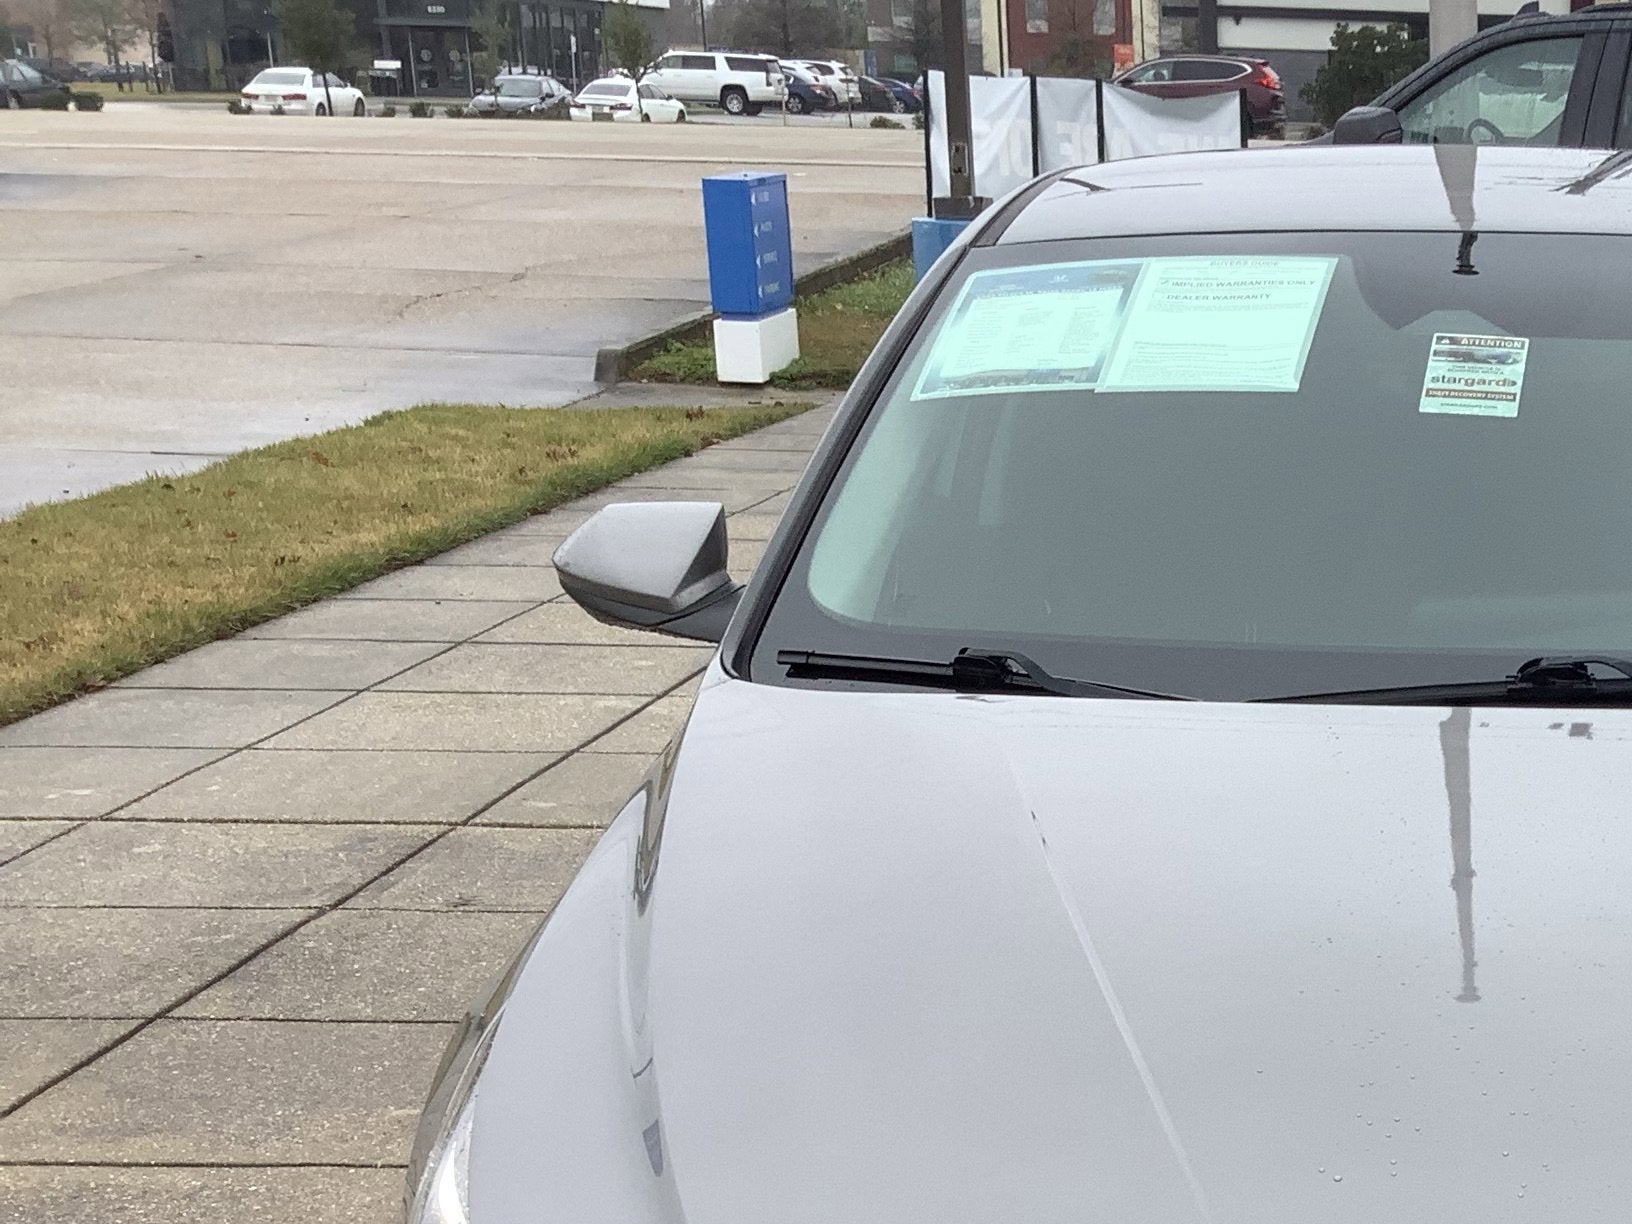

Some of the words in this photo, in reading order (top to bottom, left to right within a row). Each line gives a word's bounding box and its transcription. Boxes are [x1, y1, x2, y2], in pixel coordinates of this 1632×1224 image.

[1216, 280, 1284, 288] WARRANTIES
[1212, 293, 1272, 301] WARRANTY
[1460, 337, 1522, 348] ATTENTION
